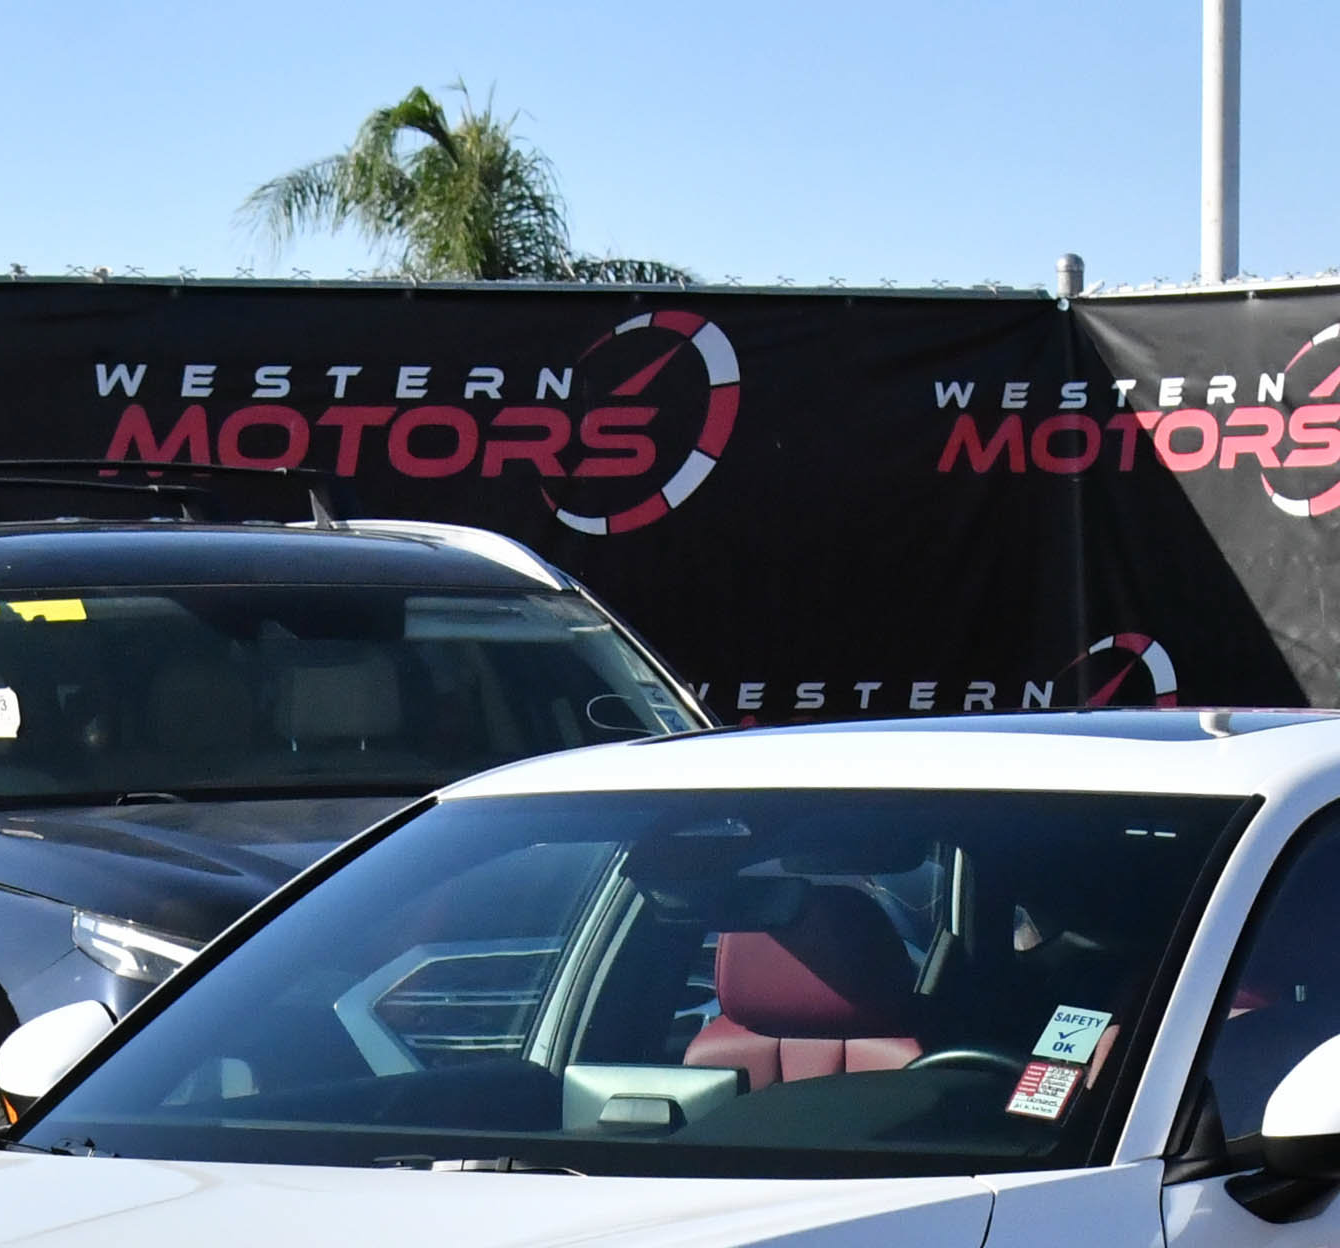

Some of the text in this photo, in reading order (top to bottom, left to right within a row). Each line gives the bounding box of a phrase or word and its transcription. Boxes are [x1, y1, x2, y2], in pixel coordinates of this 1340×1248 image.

[96, 364, 573, 400] WESTERN
[935, 373, 1285, 408] WESTERN
[100, 405, 658, 478] MOTORS
[1054, 1012, 1104, 1029] SAFETY
[1052, 1041, 1076, 1054] OK
